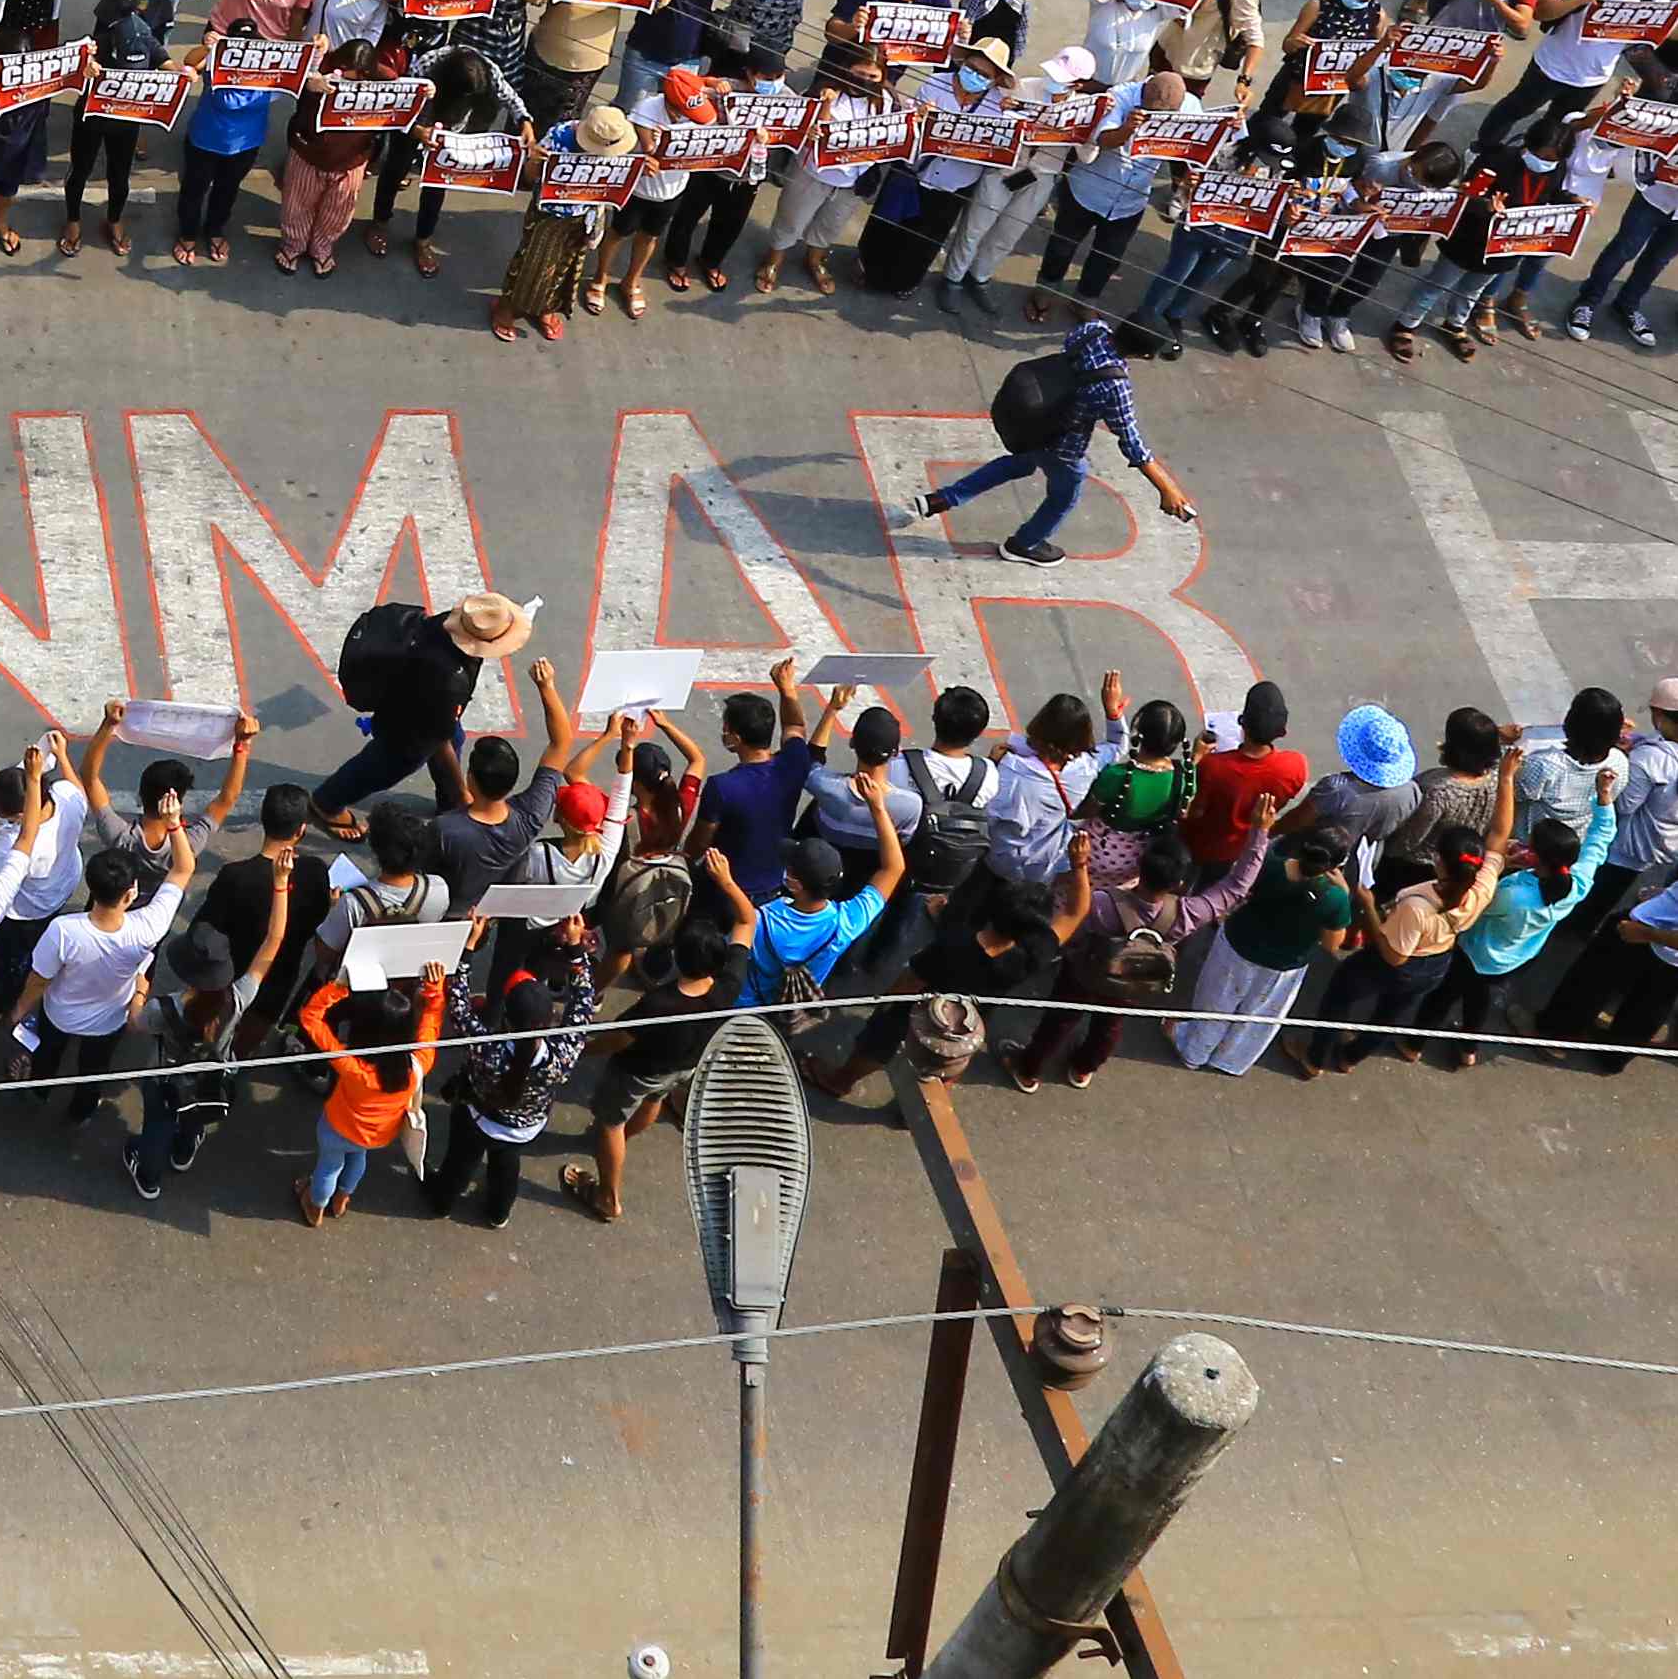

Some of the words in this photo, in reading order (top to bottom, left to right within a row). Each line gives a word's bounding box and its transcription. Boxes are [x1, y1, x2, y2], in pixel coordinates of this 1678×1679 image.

[1592, 9, 1672, 24] CRPH
[870, 17, 948, 43] CRPH
[1401, 34, 1486, 57] CRPH
[2, 55, 80, 85] CRPH
[221, 50, 298, 71] CRPH
[97, 79, 174, 103] CRPH
[335, 92, 415, 110] CRPH
[828, 126, 906, 148] CRPH
[931, 121, 1020, 146] CRPH
[1137, 119, 1215, 140] CRPH
[436, 144, 512, 169] CRPH
[666, 138, 746, 156] CRPH
[552, 164, 628, 184] CRPH
[1193, 182, 1277, 208] CRPH
[1292, 220, 1366, 237] CRPH
[1497, 214, 1578, 235] CRPH
